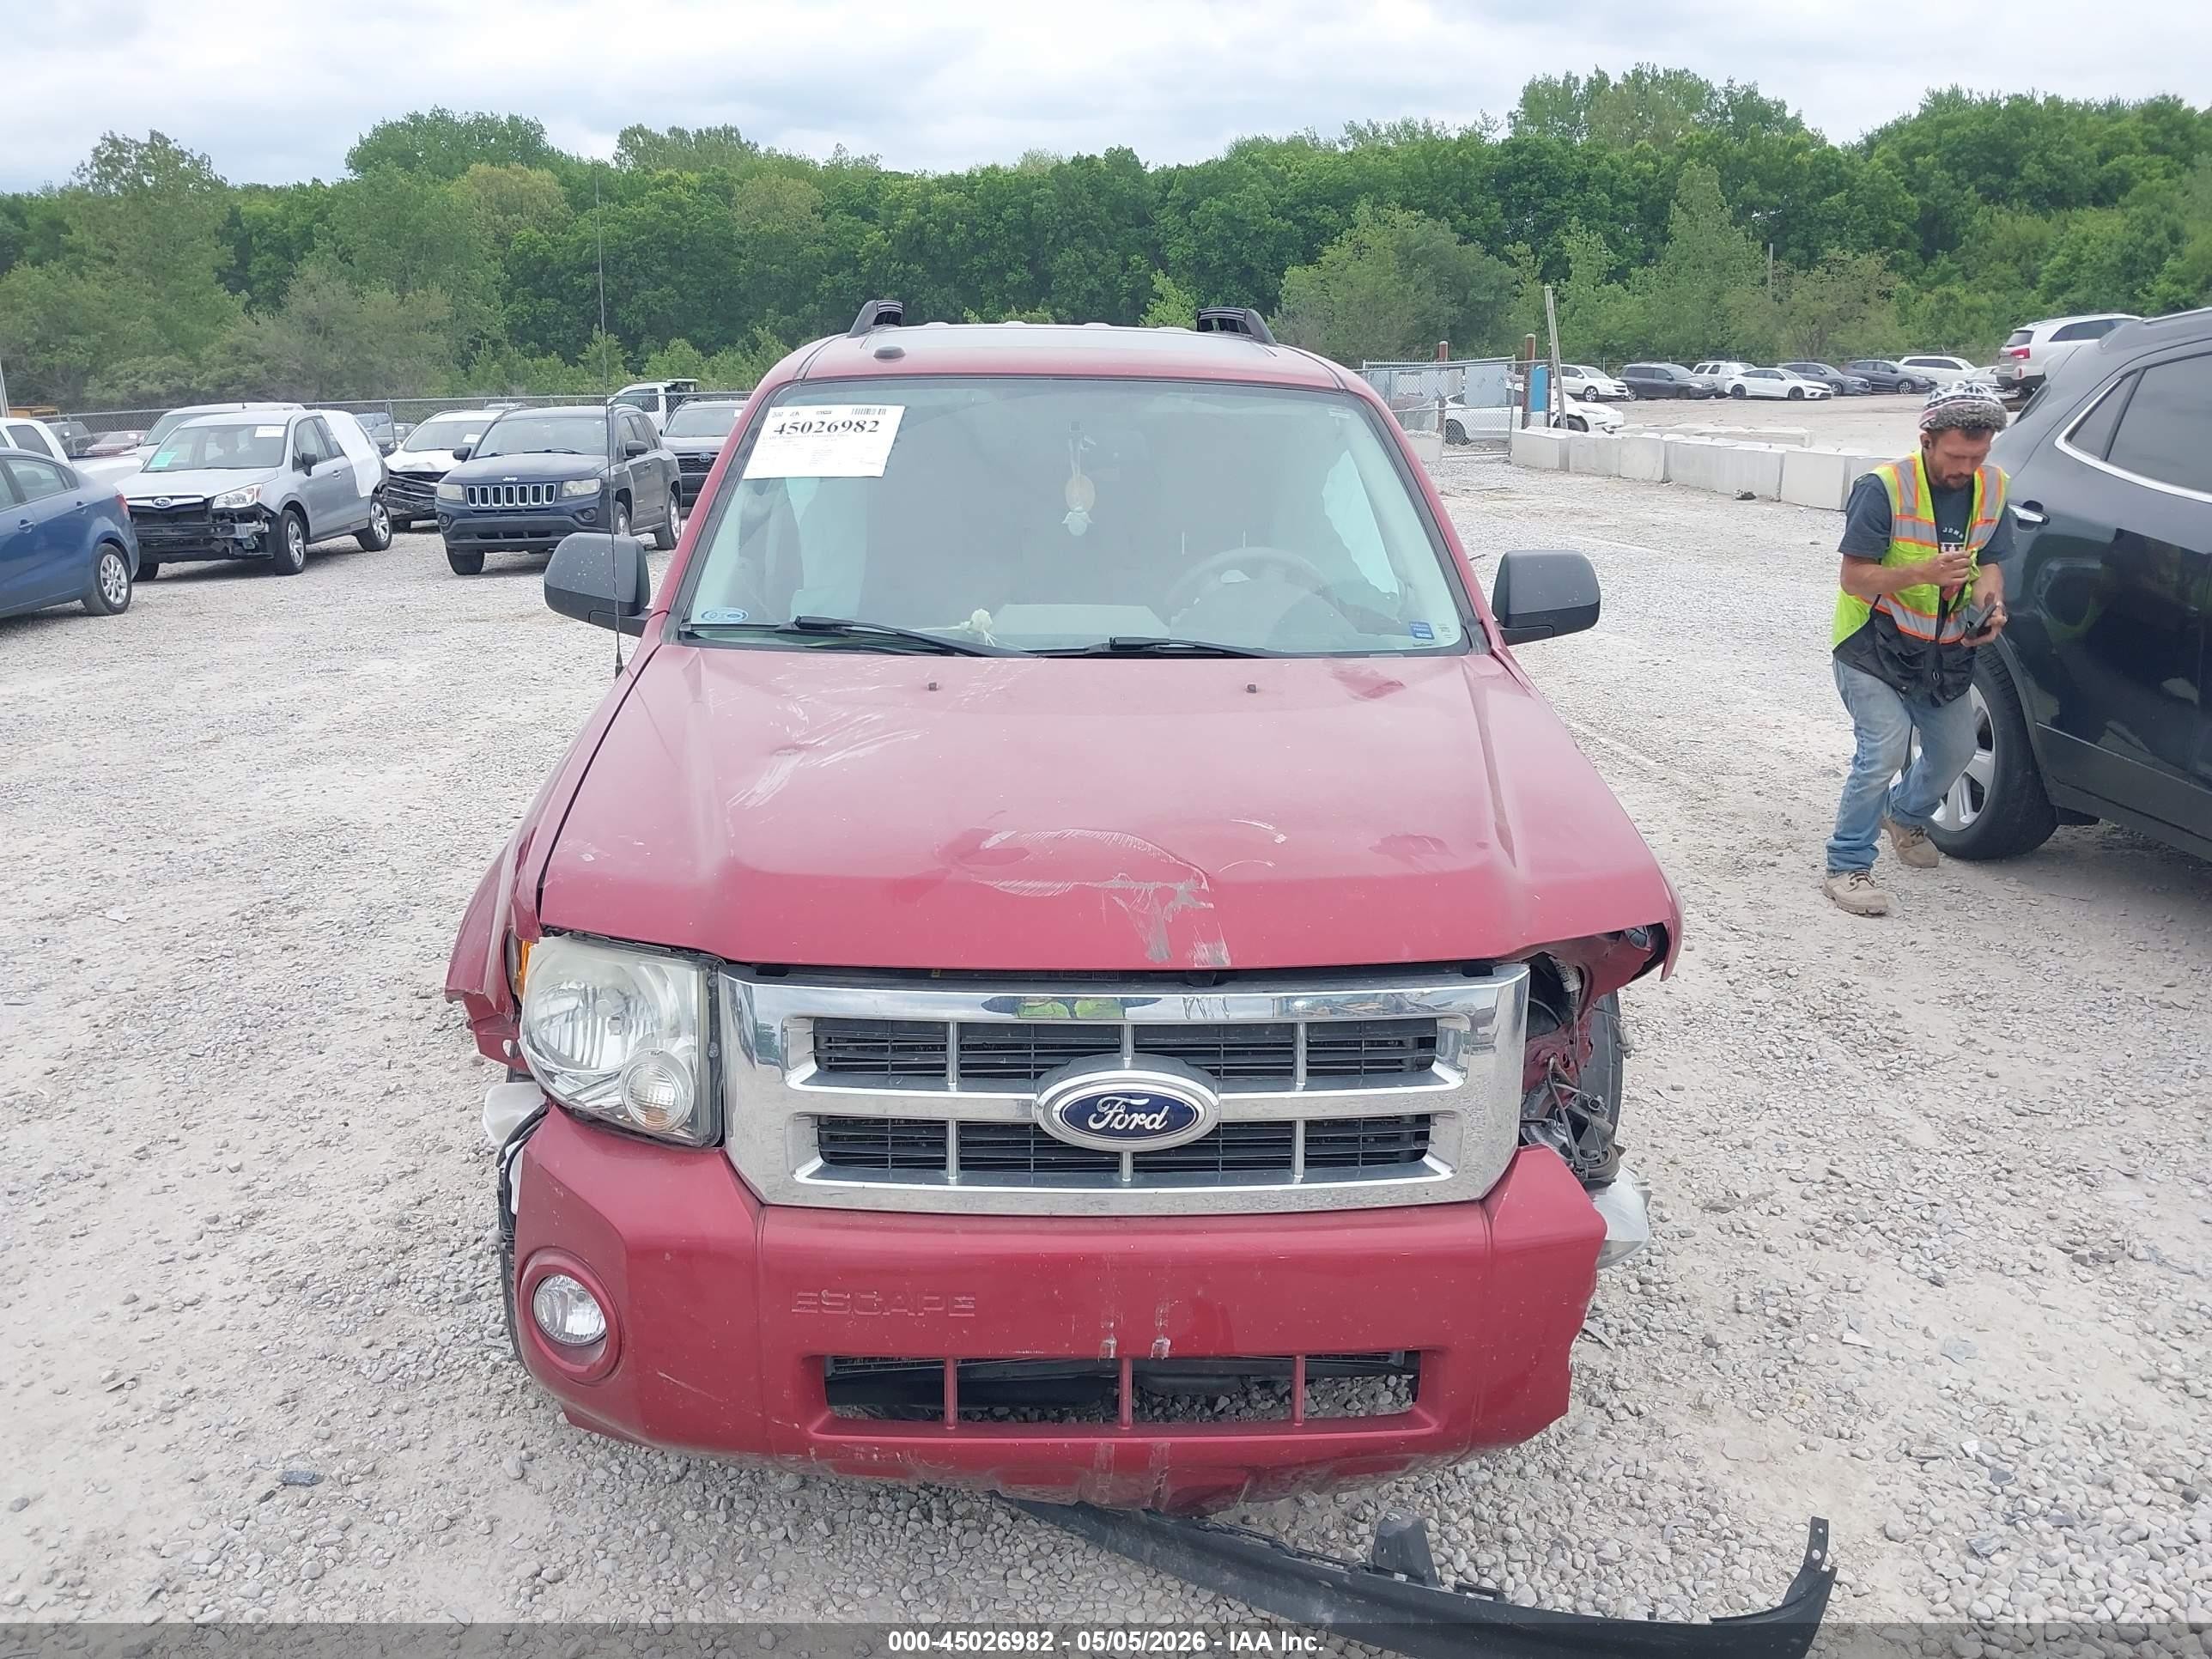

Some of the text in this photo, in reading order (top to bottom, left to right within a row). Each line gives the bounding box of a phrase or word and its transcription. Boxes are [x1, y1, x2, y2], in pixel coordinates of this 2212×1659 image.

[774, 418, 879, 434] 45026982
[1087, 1096, 1170, 1130] Ford
[791, 1290, 975, 1316] ESCAPE
